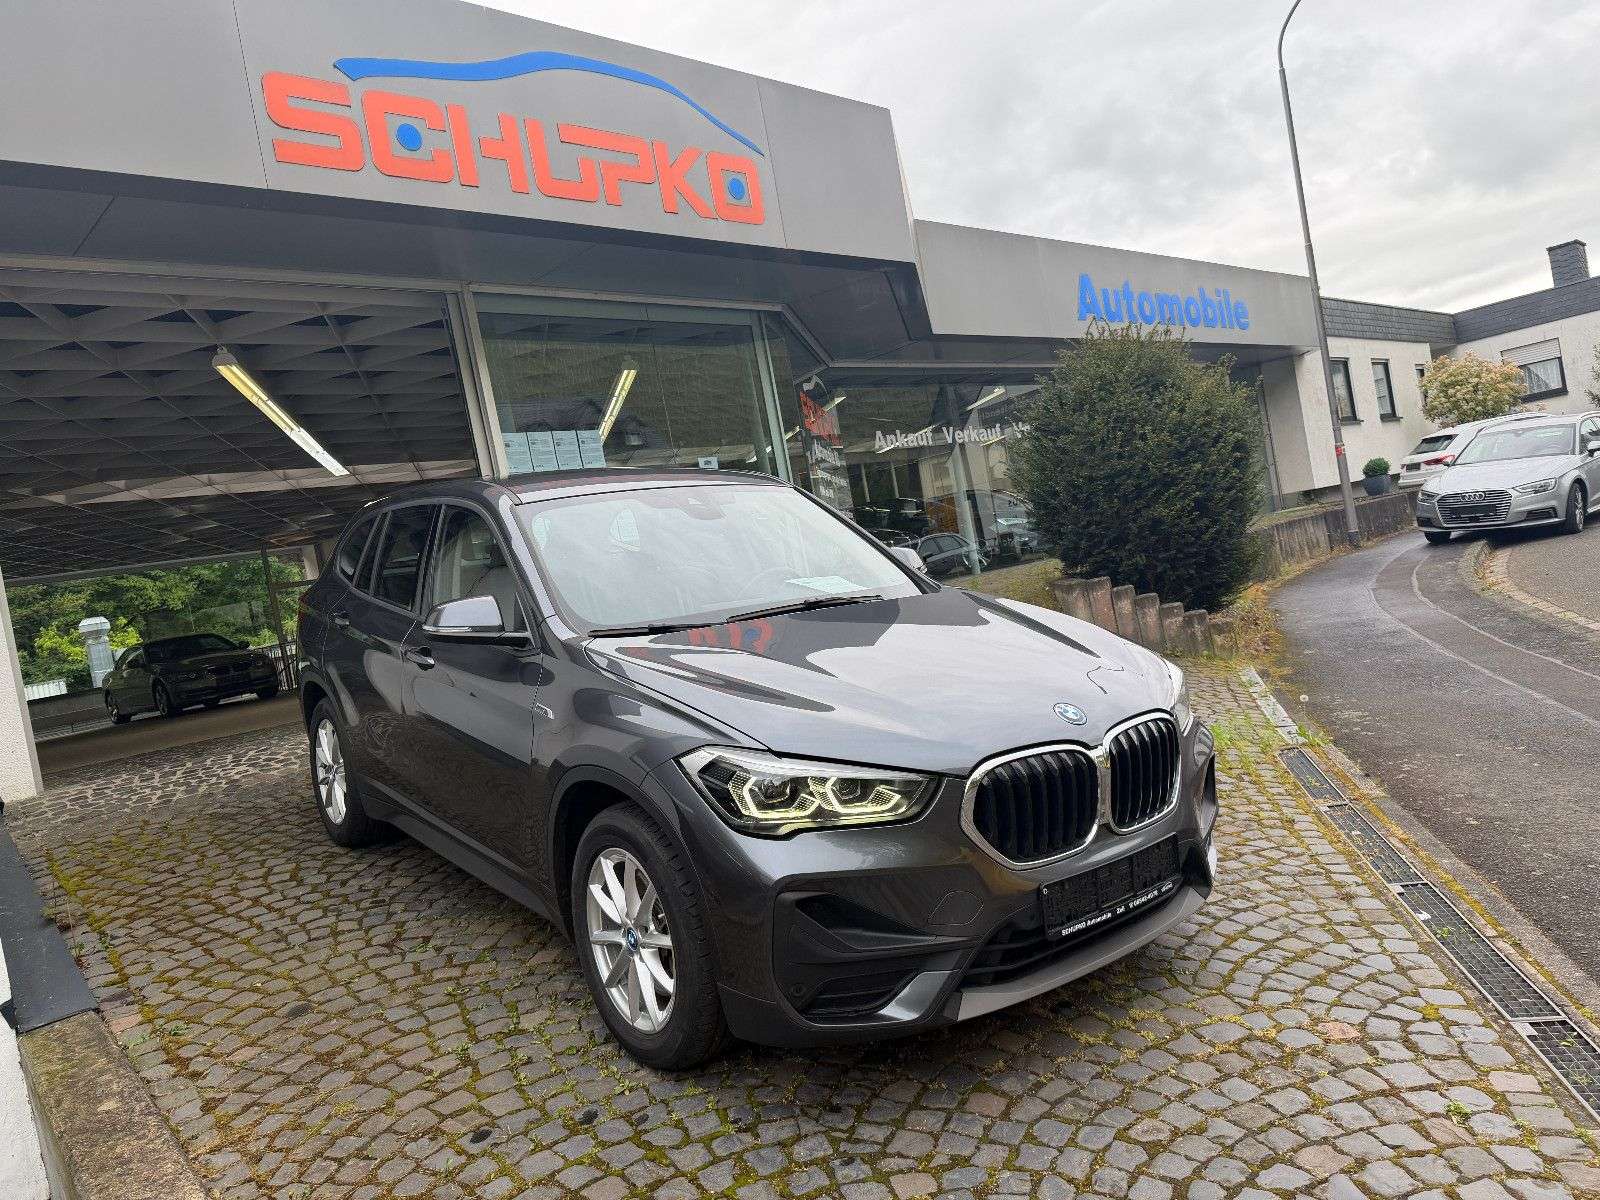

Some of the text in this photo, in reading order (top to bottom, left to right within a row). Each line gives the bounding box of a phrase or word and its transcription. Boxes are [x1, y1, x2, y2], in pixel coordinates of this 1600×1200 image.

[261, 71, 765, 225] SCHUPKO
[1077, 272, 1249, 330] Automobile
[875, 428, 933, 449] Ankauf
[943, 423, 1002, 444] Verkauf
